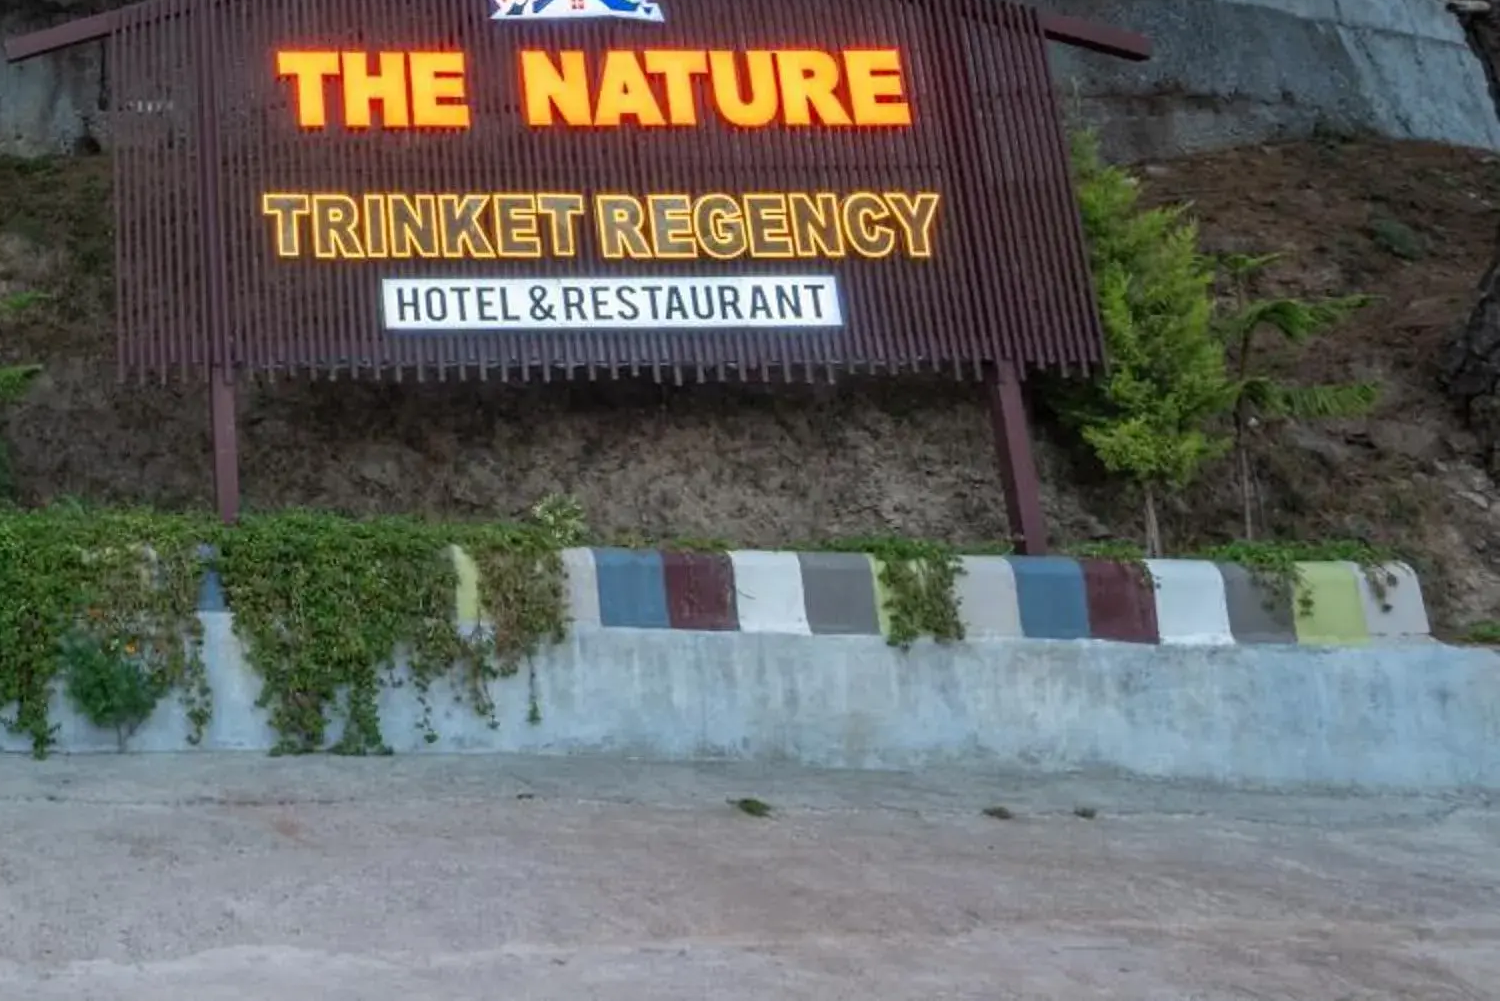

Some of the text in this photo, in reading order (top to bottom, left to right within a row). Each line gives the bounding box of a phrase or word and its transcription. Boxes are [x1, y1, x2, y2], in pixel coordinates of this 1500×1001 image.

[276, 48, 913, 130] THE NATURE
[262, 191, 940, 259] TRINKET REGENCY
